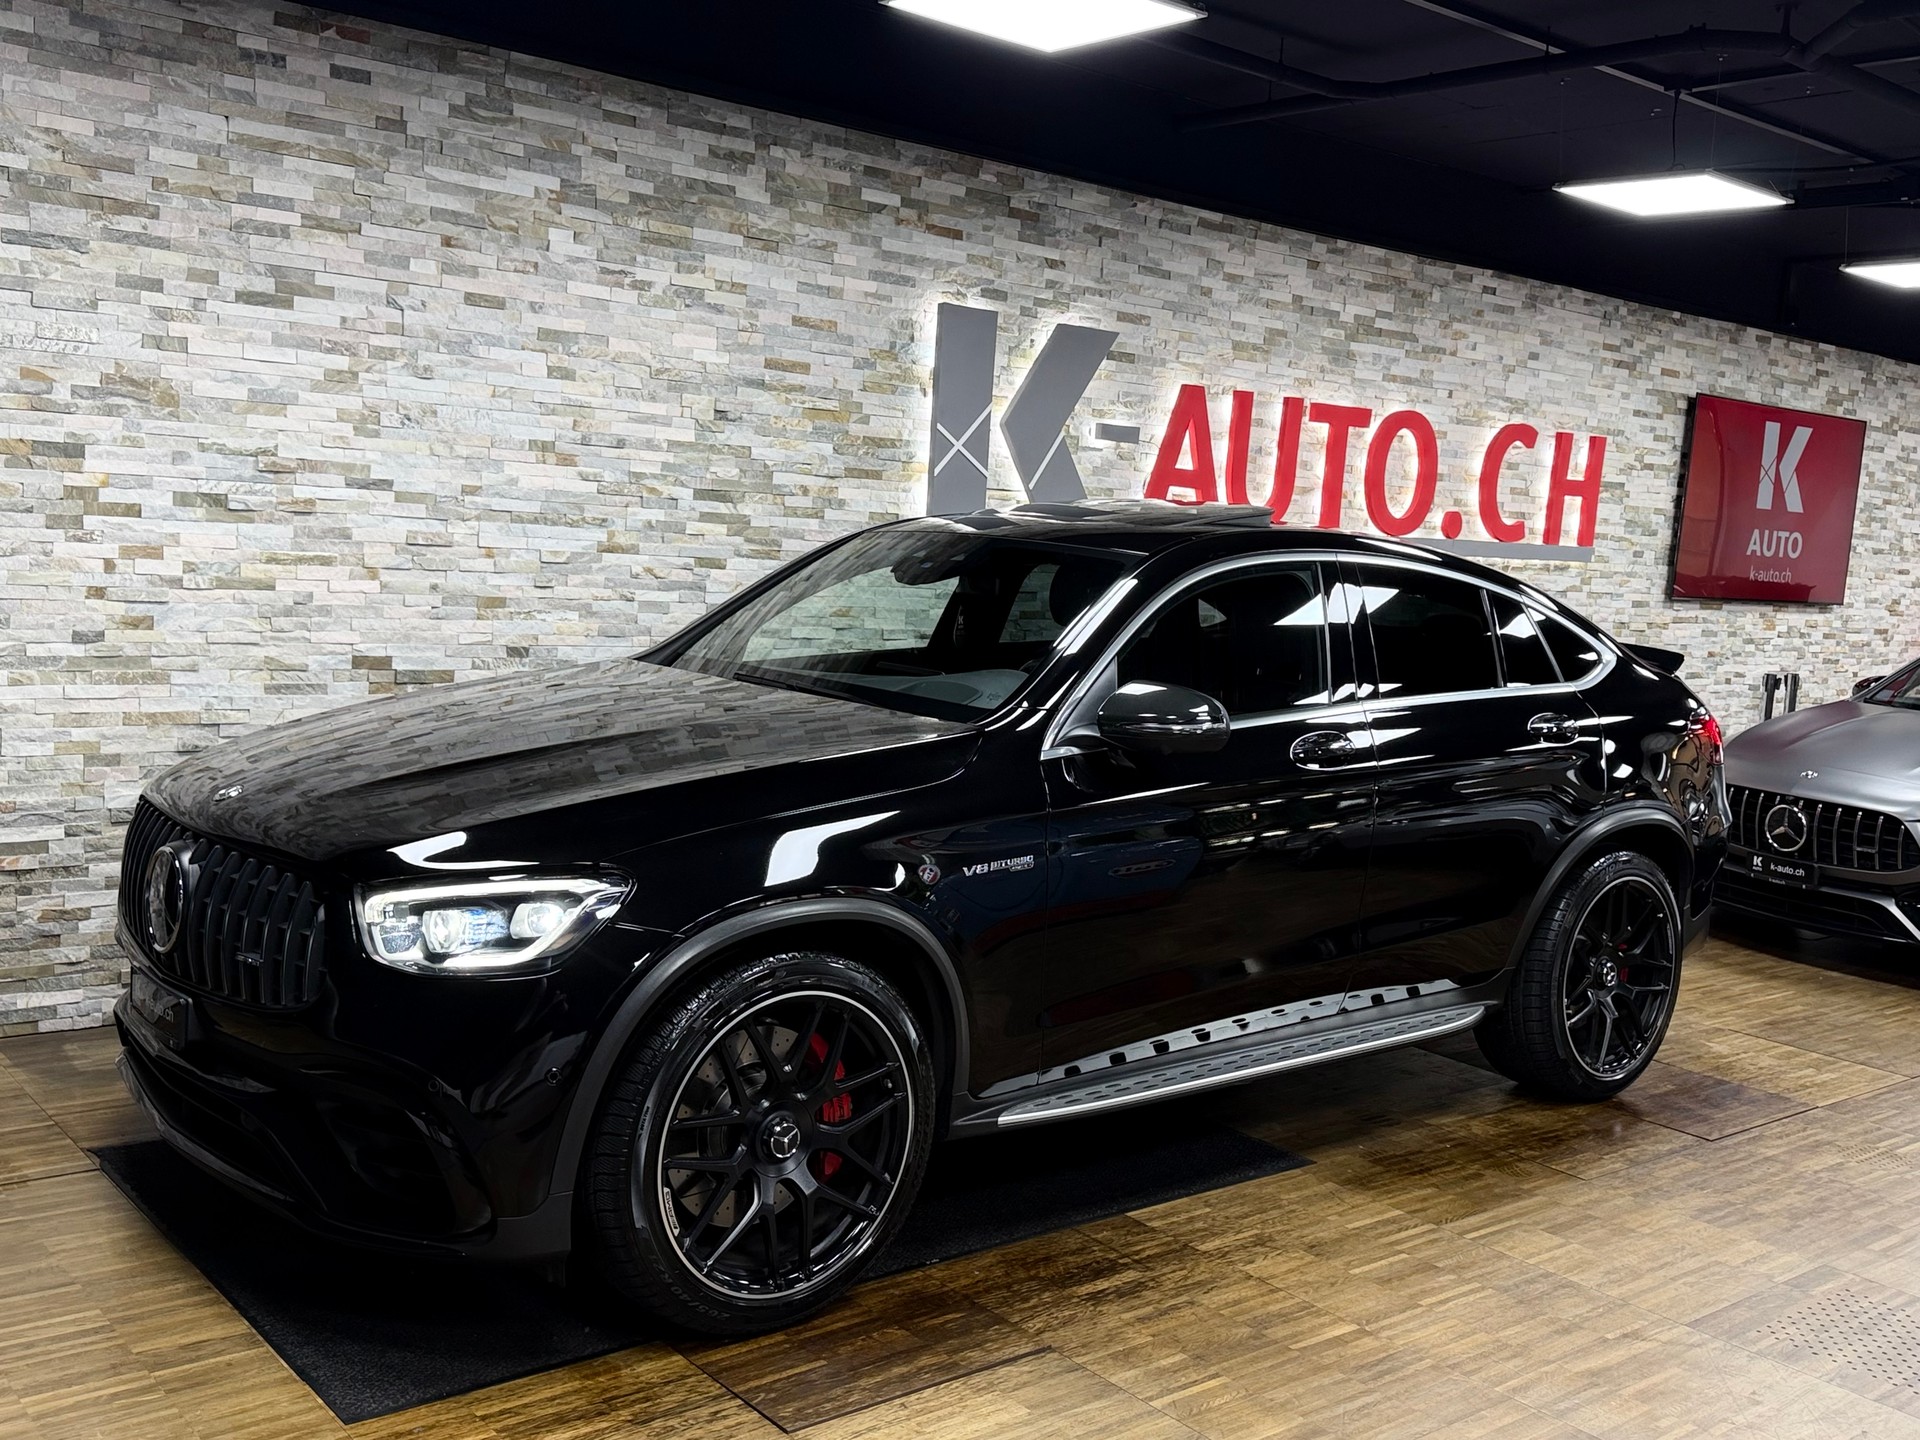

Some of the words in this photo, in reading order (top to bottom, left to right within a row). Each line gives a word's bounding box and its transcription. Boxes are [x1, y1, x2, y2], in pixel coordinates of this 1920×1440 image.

[1756, 420, 1813, 513] K
[1746, 528, 1803, 559] AUTO
[1749, 565, 1792, 583] k-auto.ch
[1753, 855, 1763, 867] K
[962, 863, 988, 877] V8
[1770, 862, 1805, 877] k-auto.ch
